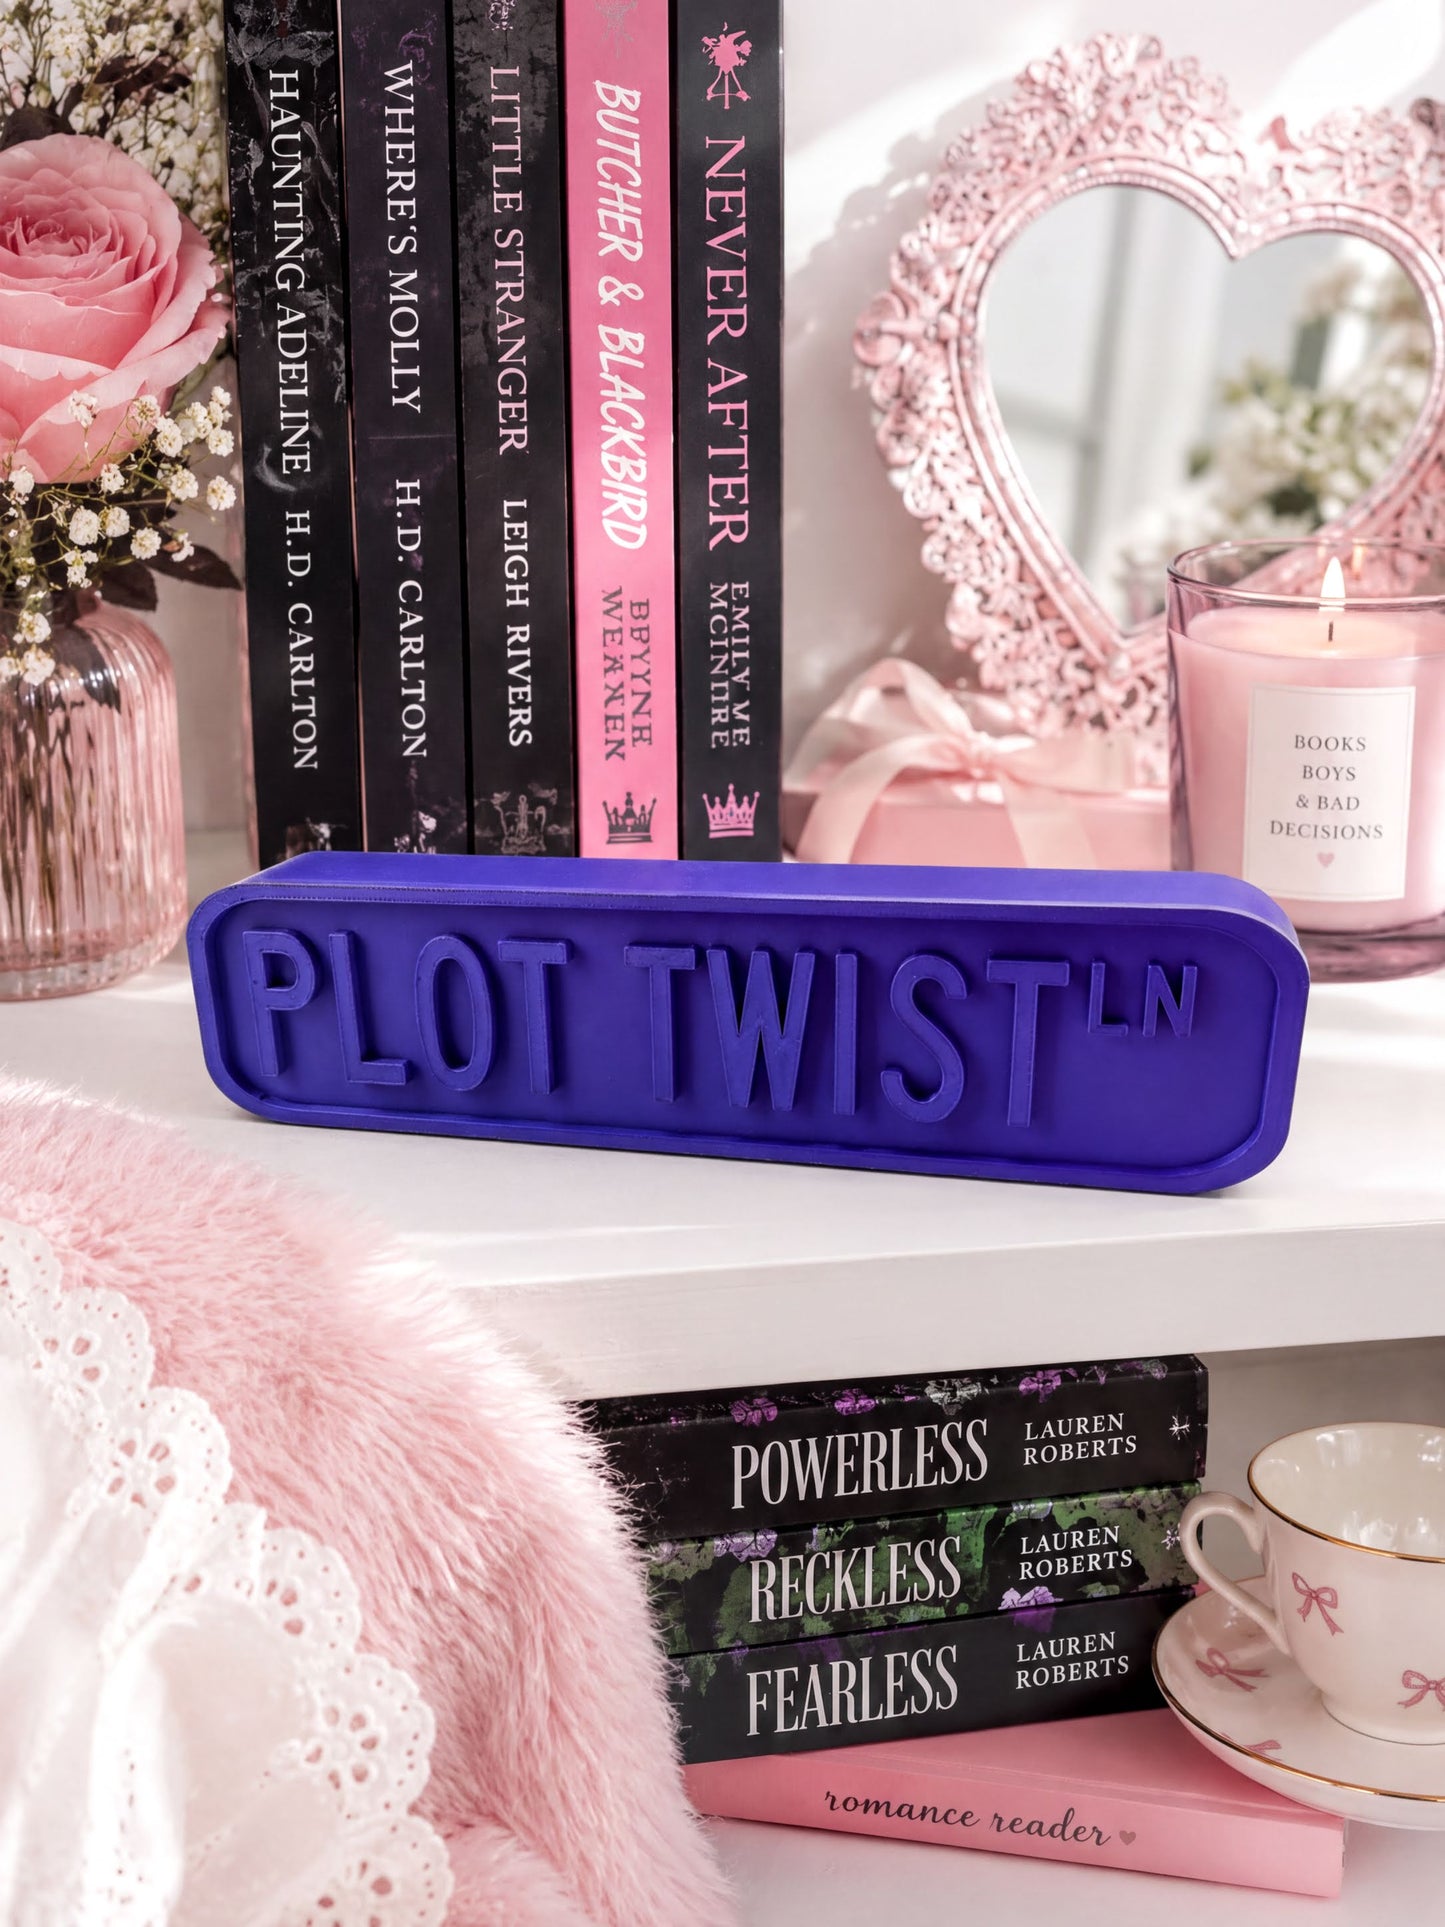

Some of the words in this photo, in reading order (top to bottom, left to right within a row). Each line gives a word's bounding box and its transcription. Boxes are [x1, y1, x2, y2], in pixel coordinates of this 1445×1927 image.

[269, 69, 305, 291] HAUNTING
[383, 60, 418, 255] WHERE'S
[490, 65, 524, 214] LITTLE
[593, 80, 643, 262] BUTCHER
[705, 136, 748, 346] NEVER
[598, 276, 644, 307] &
[388, 271, 421, 414] MOLLY
[494, 229, 529, 456] STRANGER
[277, 303, 311, 475] ADELINE
[600, 323, 648, 550] BLACKBIRD
[707, 358, 749, 551] AFTER
[285, 510, 311, 588] H.D.
[395, 479, 421, 563] H.D.
[503, 499, 529, 607] LEIGH
[287, 602, 318, 769] CARLTON
[398, 580, 427, 759] CARLTON
[506, 624, 533, 748] RIVERS
[1294, 735, 1367, 752] BOOKS
[1302, 765, 1357, 781] BOYS
[1270, 820, 1384, 840] DECISIONS
[1296, 794, 1310, 809] &
[1317, 795, 1361, 811] BAD
[242, 928, 573, 1095] PLOT
[623, 944, 1070, 1128] TWIST
[1088, 961, 1198, 1037] LN
[731, 1418, 988, 1510] POWERLESS
[1023, 1434, 1138, 1467] ROBERTS
[1024, 1412, 1126, 1441] LAUREN
[748, 1535, 963, 1624] RECKLESS
[1018, 1549, 1134, 1582] ROBERTS
[1020, 1525, 1121, 1556] LAUREN
[746, 1645, 959, 1738] FEARLESS
[1015, 1655, 1131, 1691] ROBERTS
[1016, 1631, 1116, 1664] LAUREN
[822, 1788, 980, 1828] romance
[991, 1806, 1113, 1848] reader
